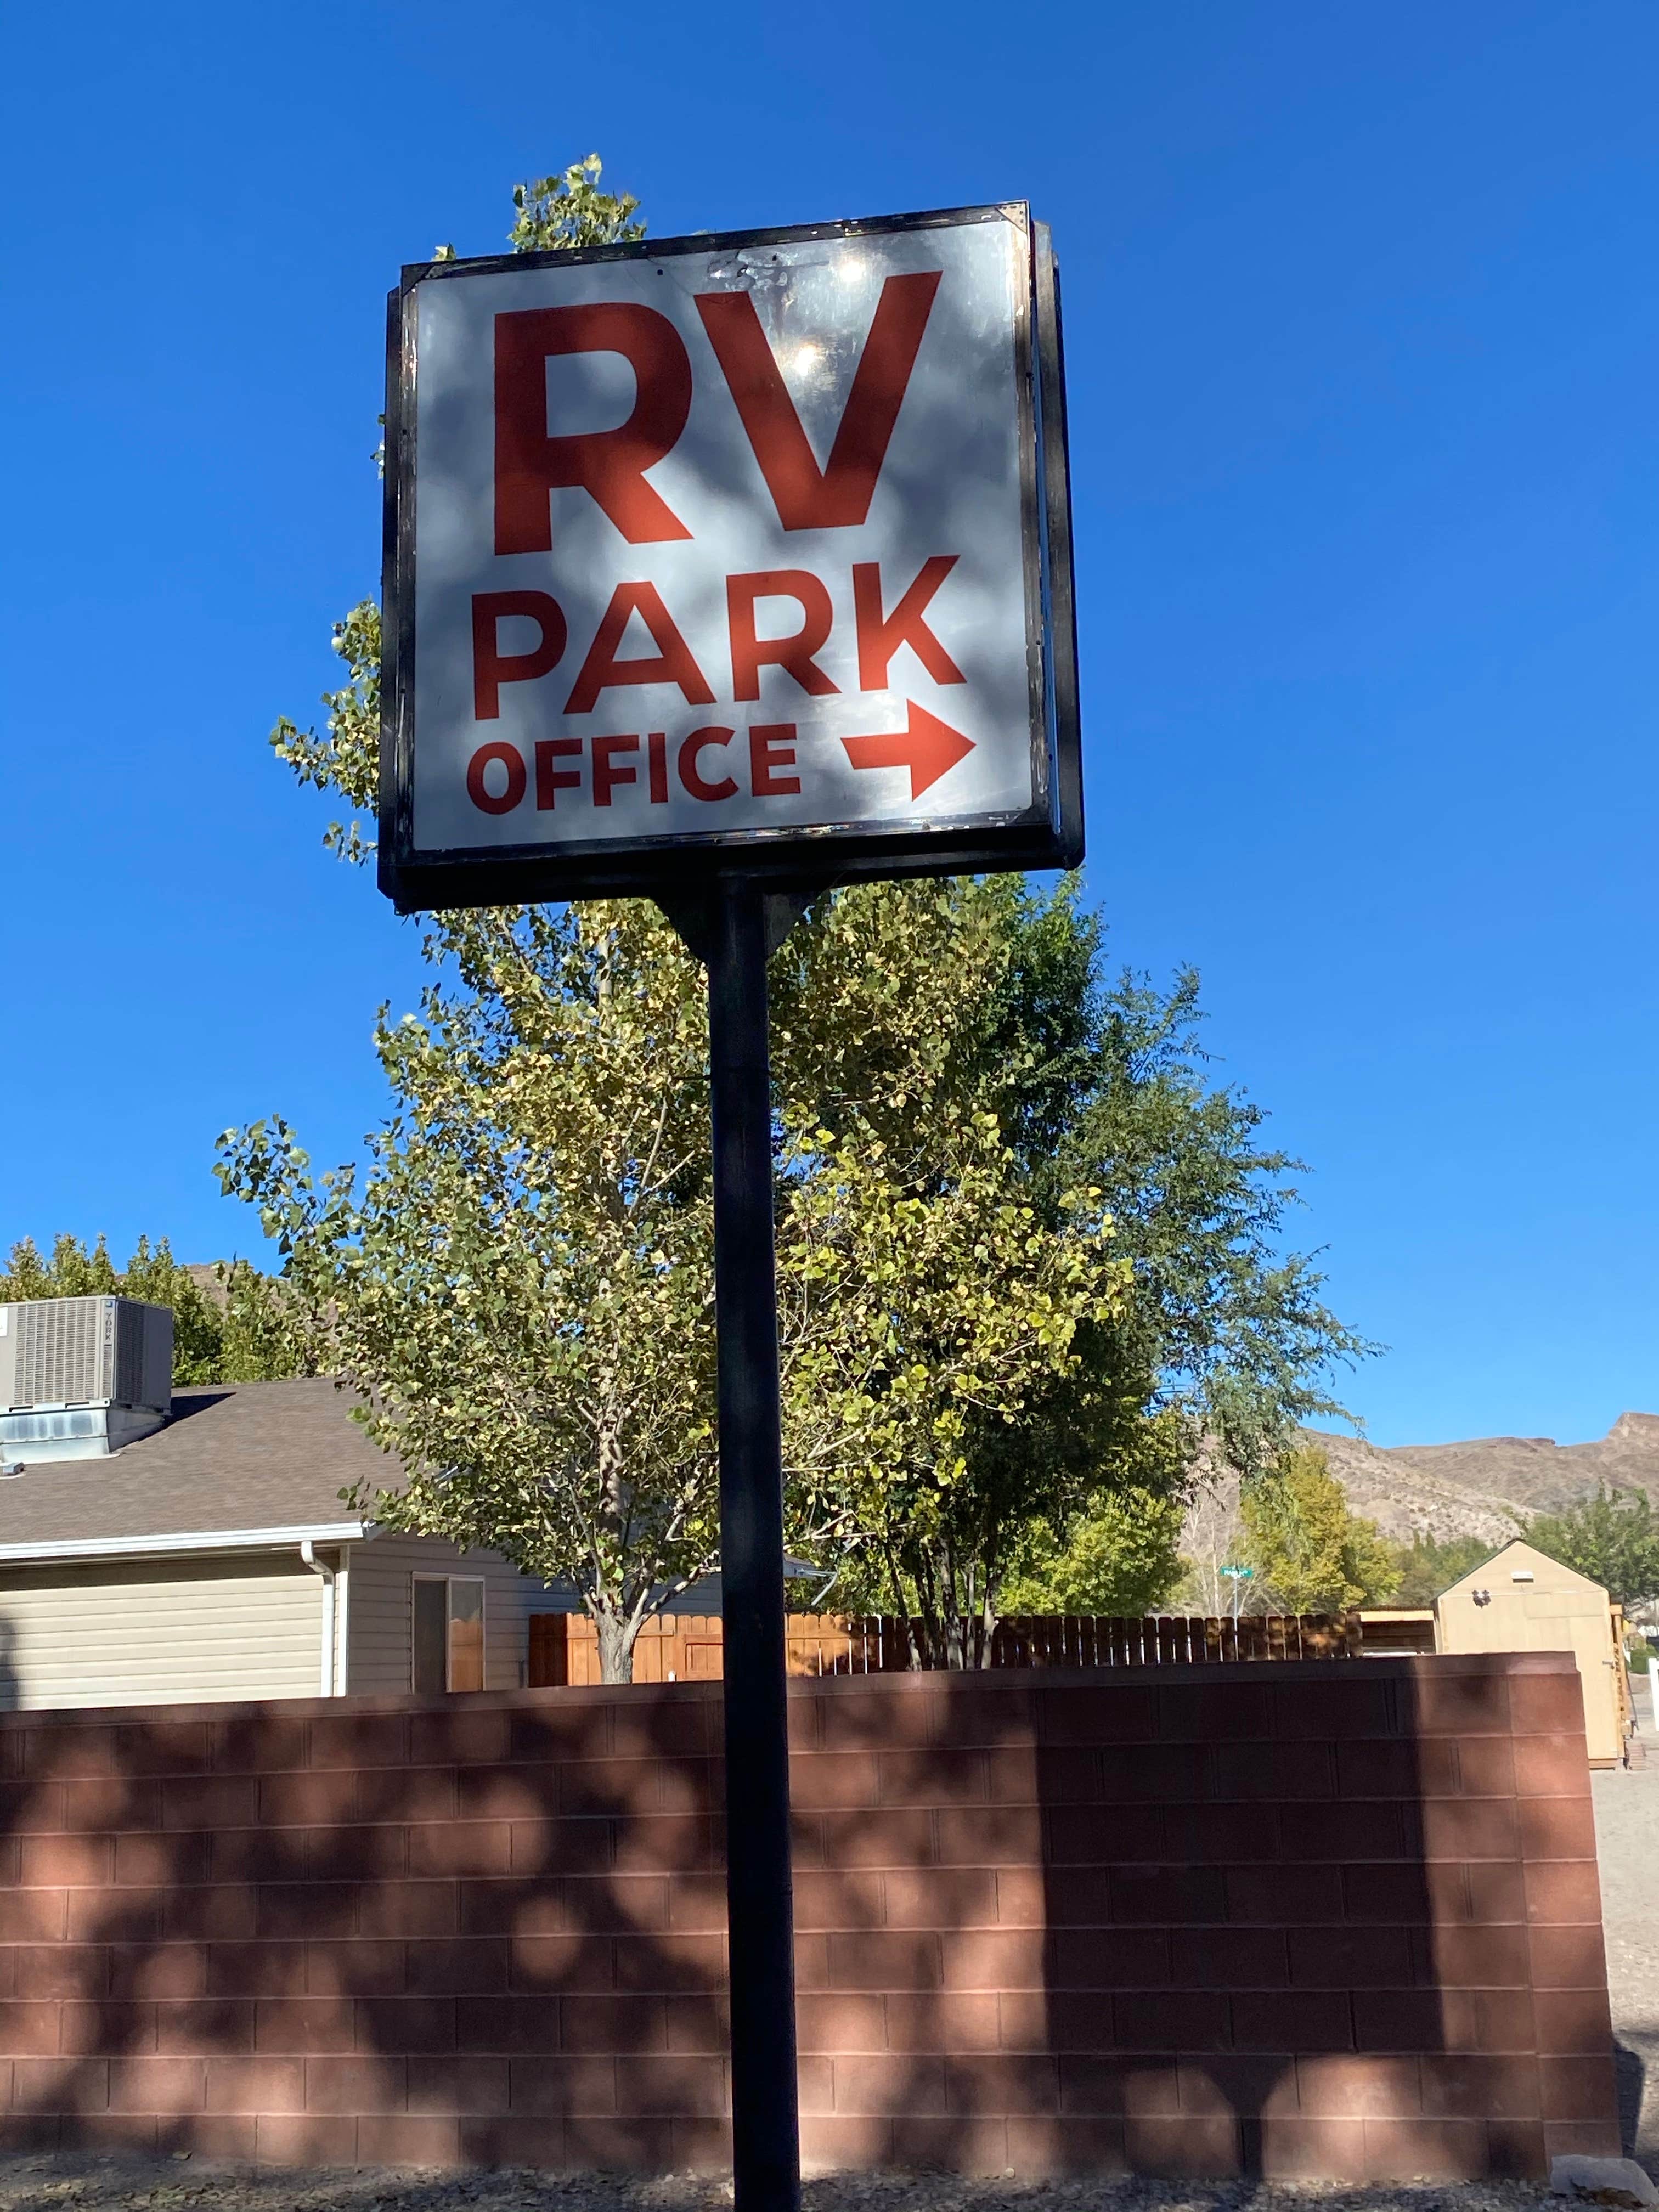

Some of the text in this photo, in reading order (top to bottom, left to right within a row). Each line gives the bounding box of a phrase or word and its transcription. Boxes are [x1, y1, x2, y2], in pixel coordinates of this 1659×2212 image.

[493, 271, 944, 556] RV
[471, 555, 968, 720] PARK
[466, 723, 801, 816] OFFICE
